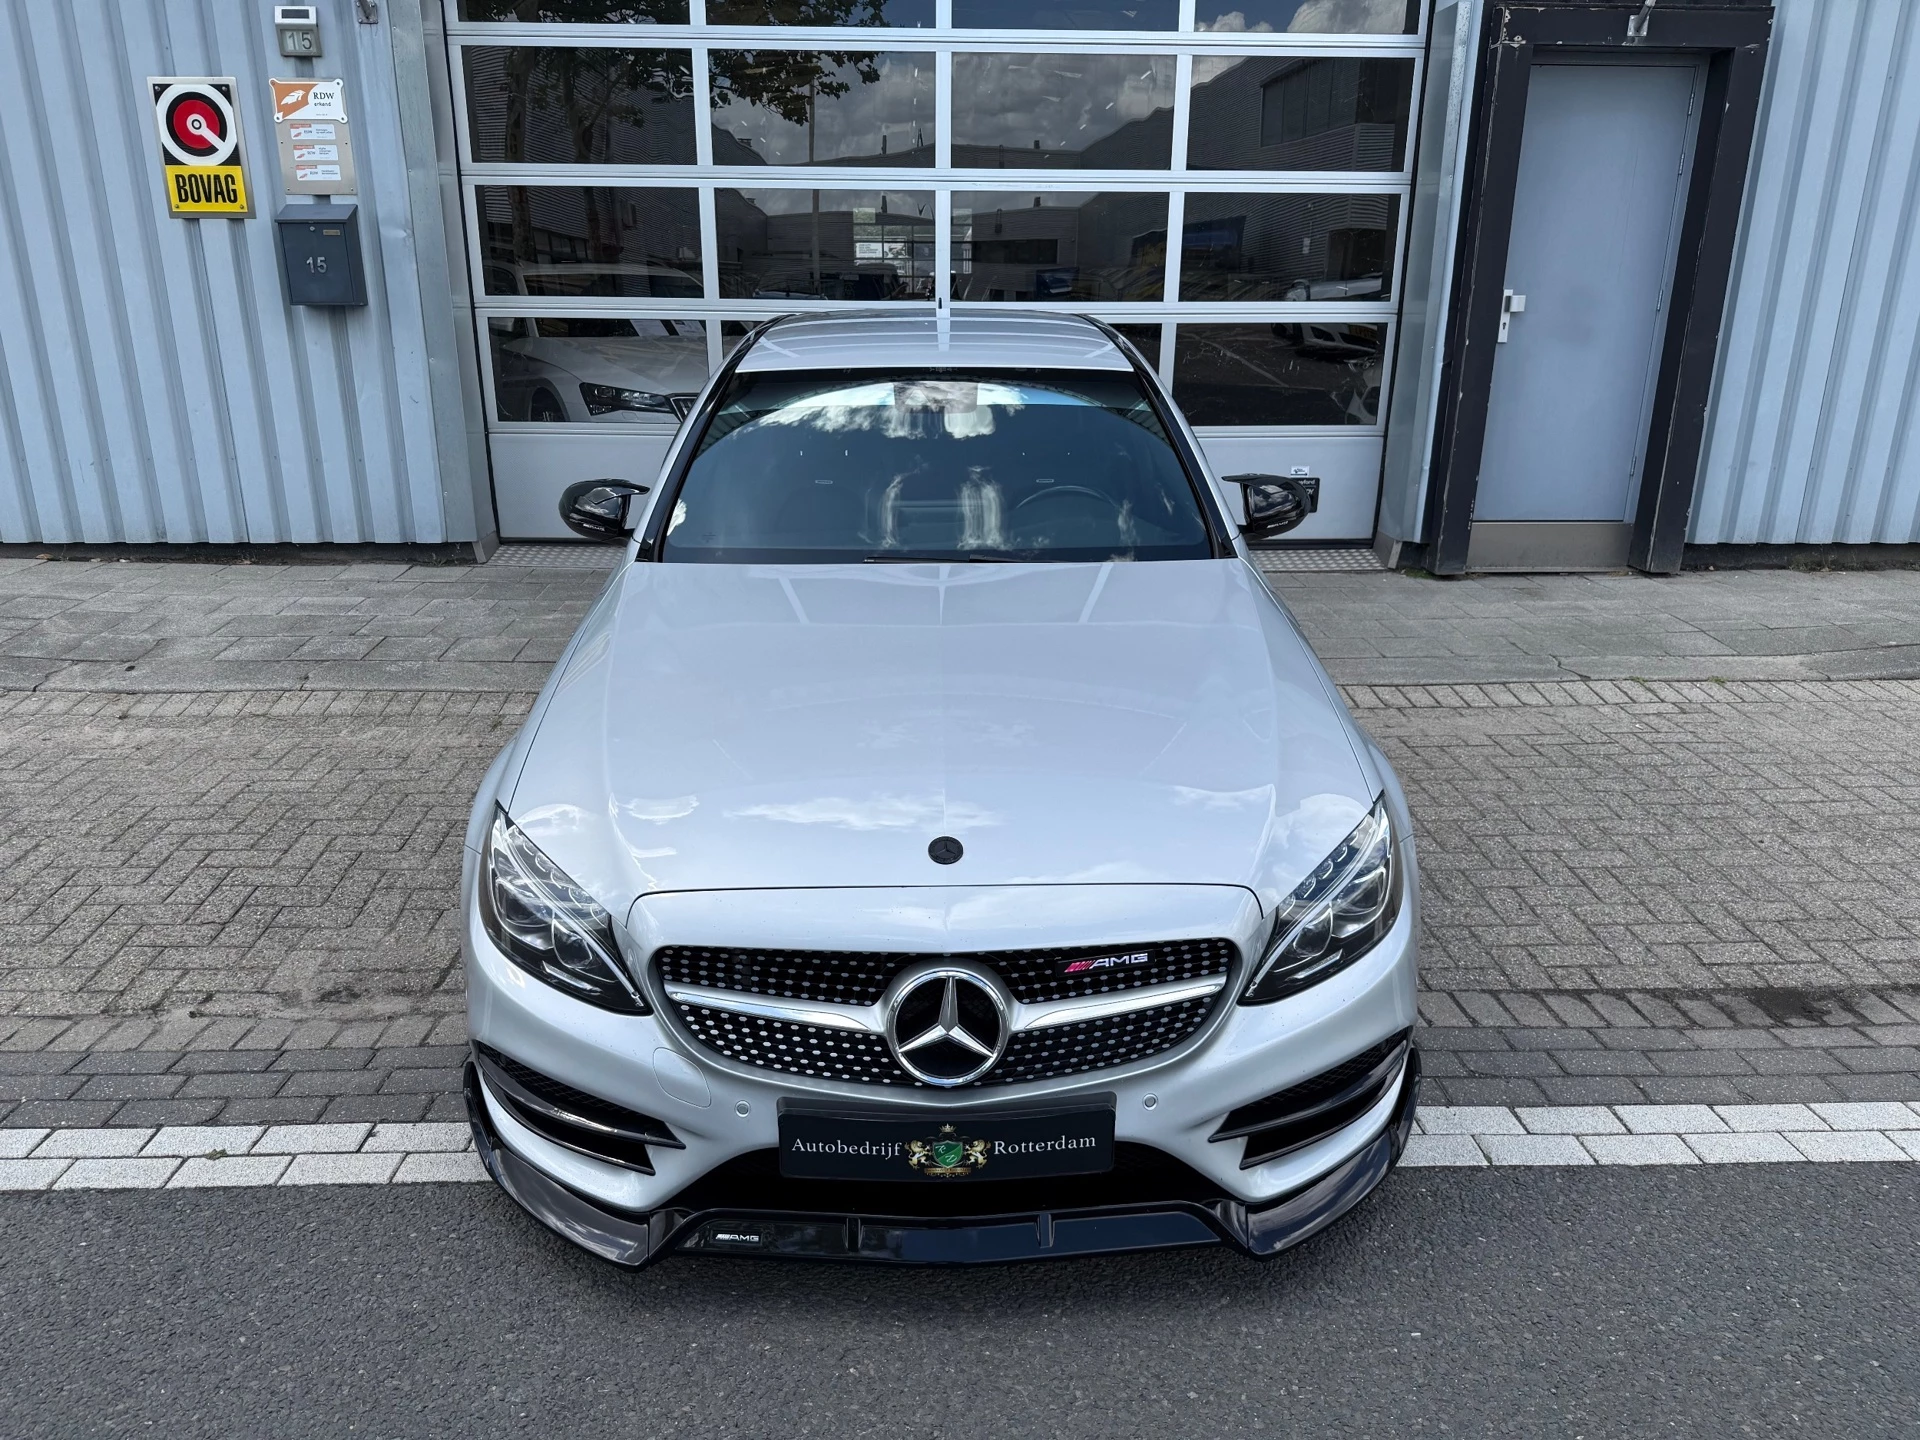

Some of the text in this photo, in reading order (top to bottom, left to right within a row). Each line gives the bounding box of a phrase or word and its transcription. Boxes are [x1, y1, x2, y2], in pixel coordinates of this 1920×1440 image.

[287, 31, 312, 50] 15
[313, 91, 335, 100] RDW
[174, 173, 239, 204] BOVAG
[306, 256, 327, 274] 15
[1089, 952, 1149, 970] AMG
[791, 1134, 1097, 1161] Autobedrijf Rotterdam
[729, 1234, 760, 1242] AMG
